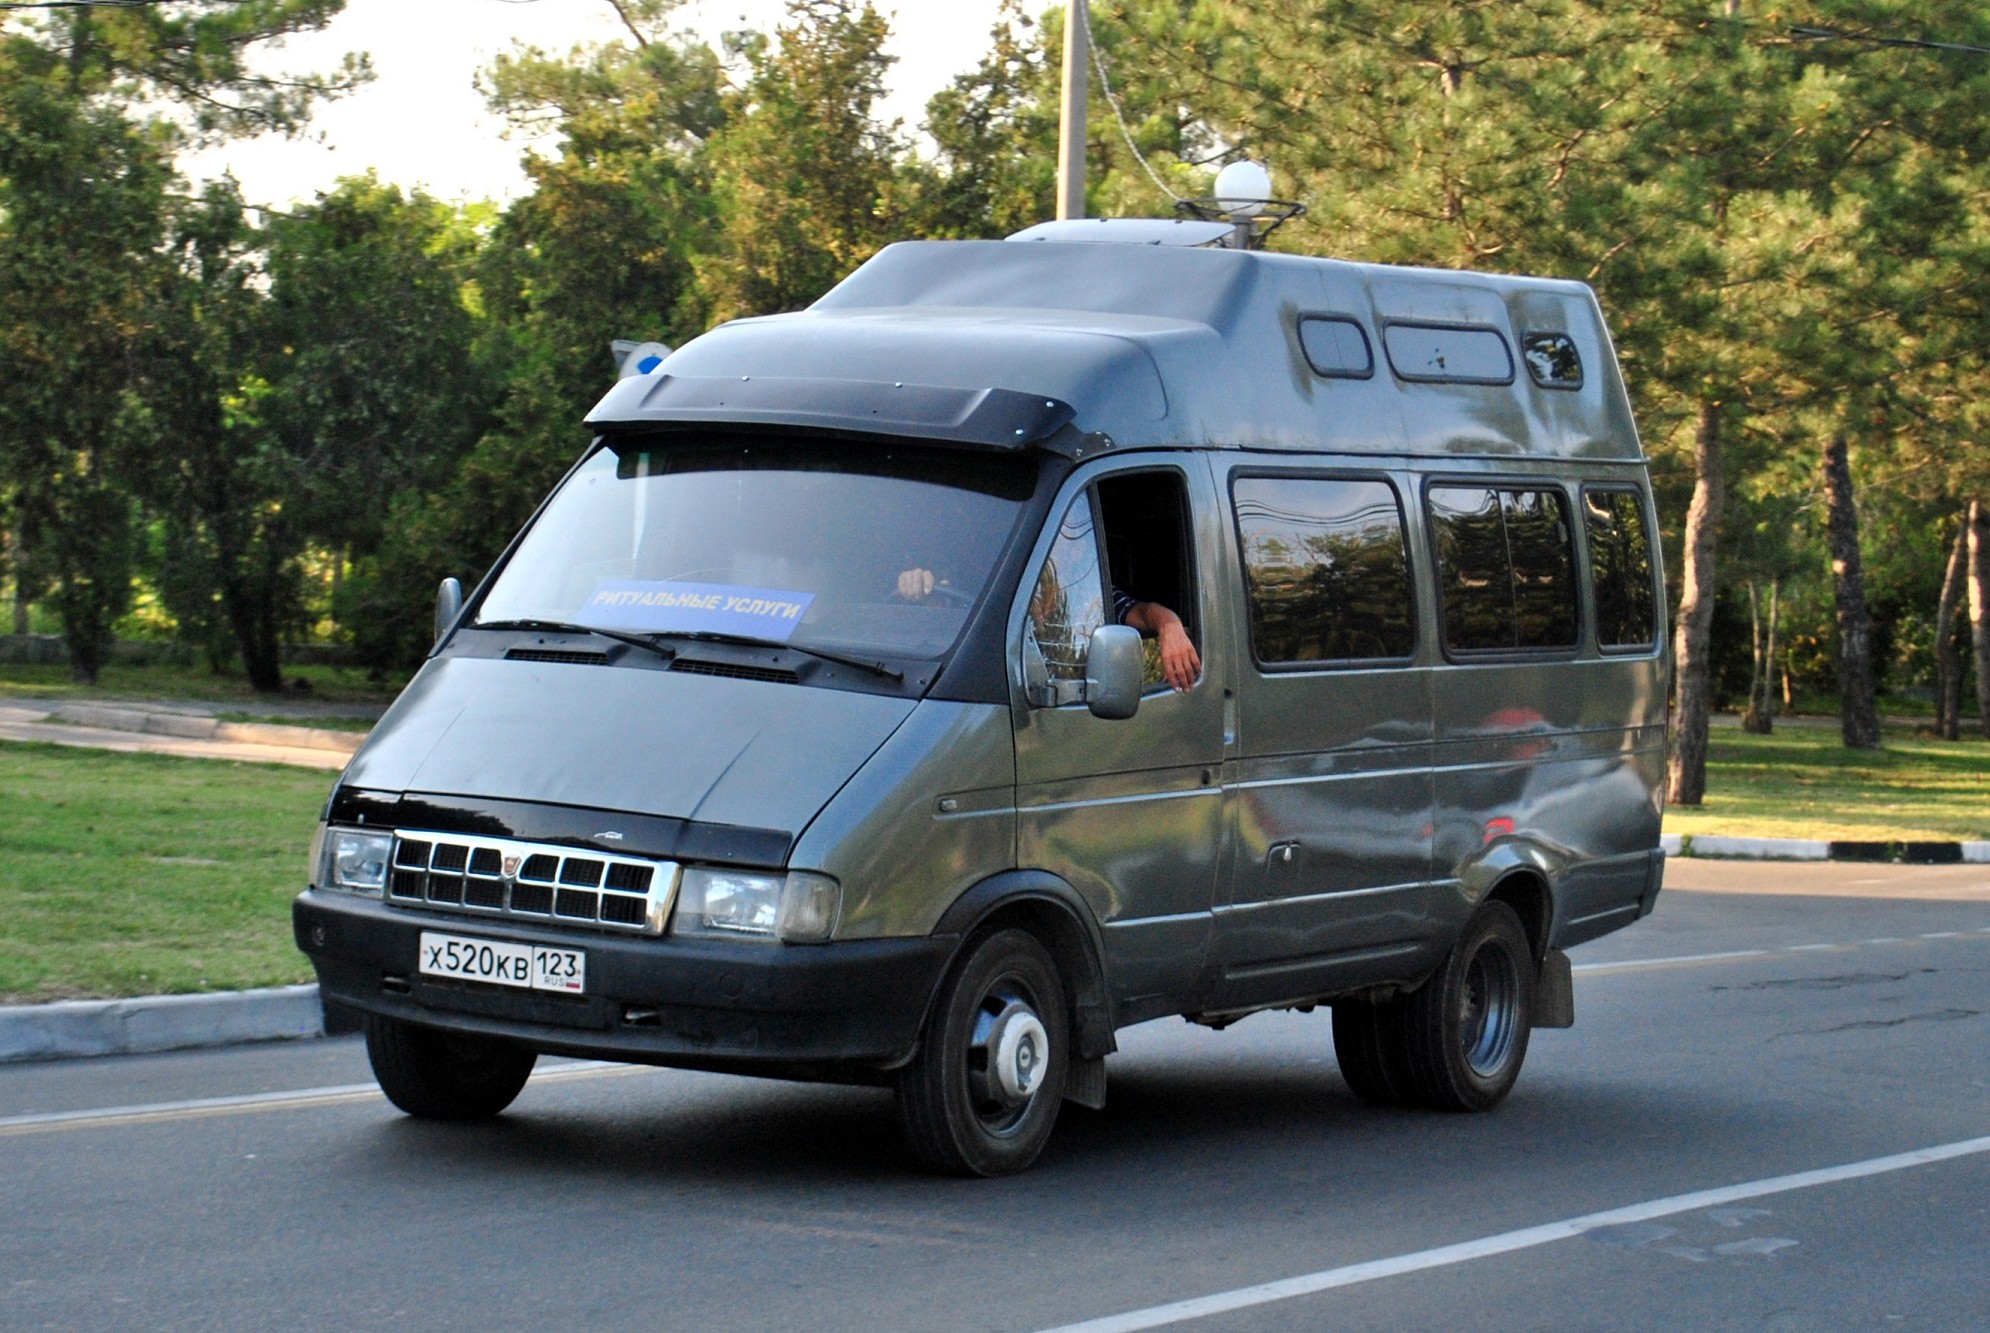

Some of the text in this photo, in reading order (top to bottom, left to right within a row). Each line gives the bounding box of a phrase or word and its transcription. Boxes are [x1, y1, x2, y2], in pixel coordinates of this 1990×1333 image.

[593, 591, 801, 619] РИТУАЛЬНЫЕ УСЛУГИ
[537, 952, 577, 977] 123
[544, 976, 565, 986] RUS
